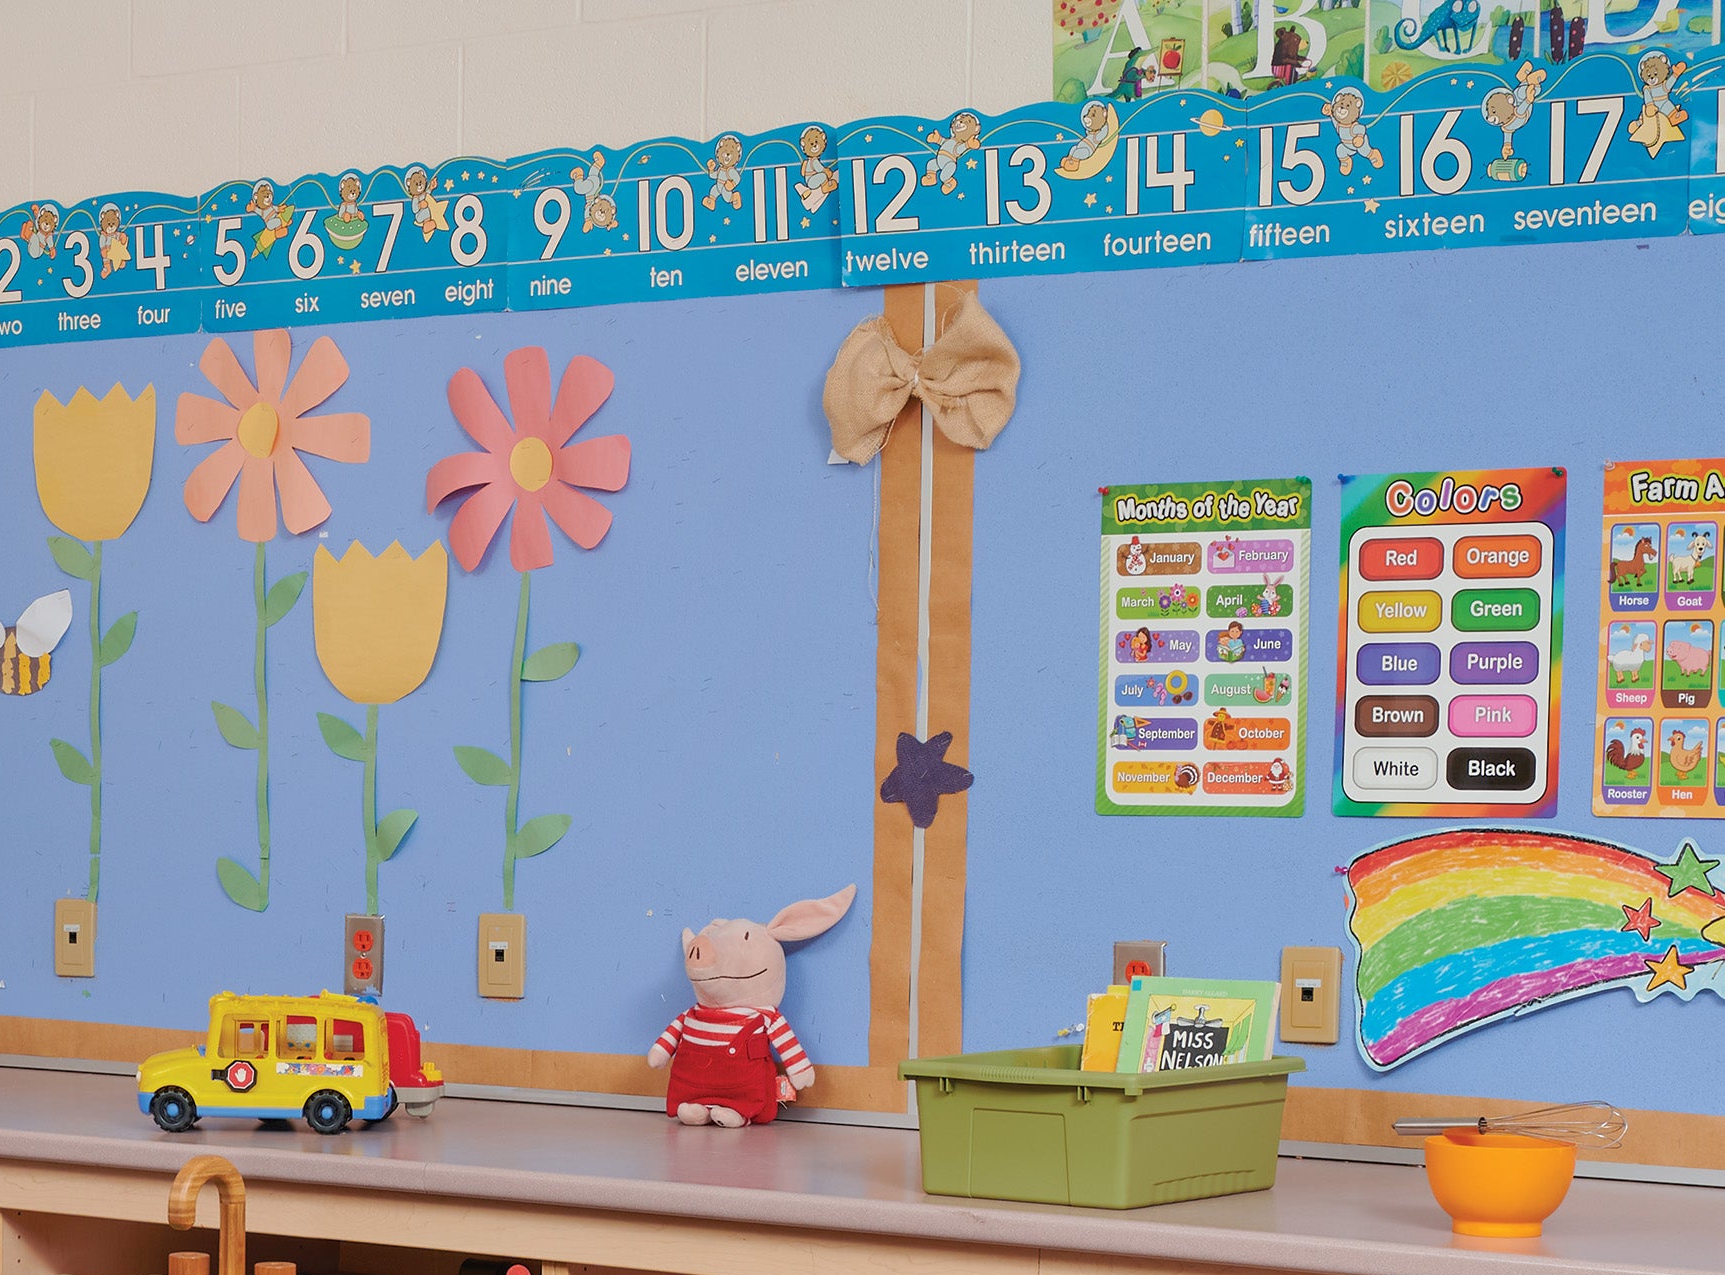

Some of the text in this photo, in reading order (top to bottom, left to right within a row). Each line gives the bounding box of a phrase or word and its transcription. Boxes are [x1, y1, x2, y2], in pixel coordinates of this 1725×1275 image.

[62, 231, 94, 298] 3
[135, 224, 171, 290] 4
[213, 217, 247, 286] 5
[288, 210, 325, 280] 6
[372, 203, 405, 273] 7
[449, 193, 489, 268] 8
[533, 187, 572, 260] 9
[637, 174, 695, 252] 10
[752, 166, 790, 244] 11
[851, 154, 920, 235] 12
[984, 144, 1053, 226] 13
[1125, 131, 1194, 216] 14
[1258, 123, 1326, 208] 15
[1399, 110, 1473, 197] 16
[1549, 96, 1625, 186] 17
[57, 311, 102, 332] three
[136, 305, 171, 325] four
[214, 298, 247, 320] five
[294, 293, 320, 314] six
[360, 287, 416, 309] seven
[444, 278, 495, 306] eight
[529, 275, 572, 297] nine
[650, 265, 683, 288] ten
[735, 258, 809, 283] eleven
[845, 248, 929, 273] twelve
[969, 241, 1066, 266] thirteen
[1102, 230, 1212, 257] fourteen
[1249, 221, 1330, 249] fifteen
[1384, 211, 1485, 239] sixteen
[1513, 199, 1657, 231] seventeen
[1631, 471, 1725, 503] Farm A
[1385, 477, 1523, 517] Colors
[1117, 491, 1299, 522] Months of the Year
[1149, 552, 1195, 566] January
[1238, 550, 1289, 564] February
[1385, 549, 1417, 567] Red
[1466, 547, 1530, 567] Orange
[1121, 596, 1155, 608] March
[1215, 594, 1243, 608] April
[1618, 595, 1650, 607] Horse
[1677, 596, 1703, 608] Goat
[1375, 602, 1428, 619] Yellow
[1470, 601, 1523, 618] Green
[1169, 640, 1193, 653] May
[1253, 638, 1281, 650] June
[1381, 655, 1418, 672] Blue
[1467, 653, 1524, 673] Purple
[1121, 684, 1144, 698] July
[1210, 684, 1252, 698] August
[1615, 692, 1648, 705] Sheep
[1678, 692, 1696, 706] Pig
[1372, 707, 1424, 724] Brown
[1475, 706, 1513, 724] Pink
[1138, 727, 1195, 742] September
[1238, 727, 1285, 740] October
[1373, 760, 1420, 777] White
[1468, 760, 1517, 777] Black
[1117, 771, 1171, 783] November
[1207, 771, 1263, 784] December
[1607, 788, 1649, 801] Rooster
[1671, 789, 1694, 801] Hen
[1172, 1030, 1214, 1050] MISS
[1160, 1049, 1223, 1070] NELSON
